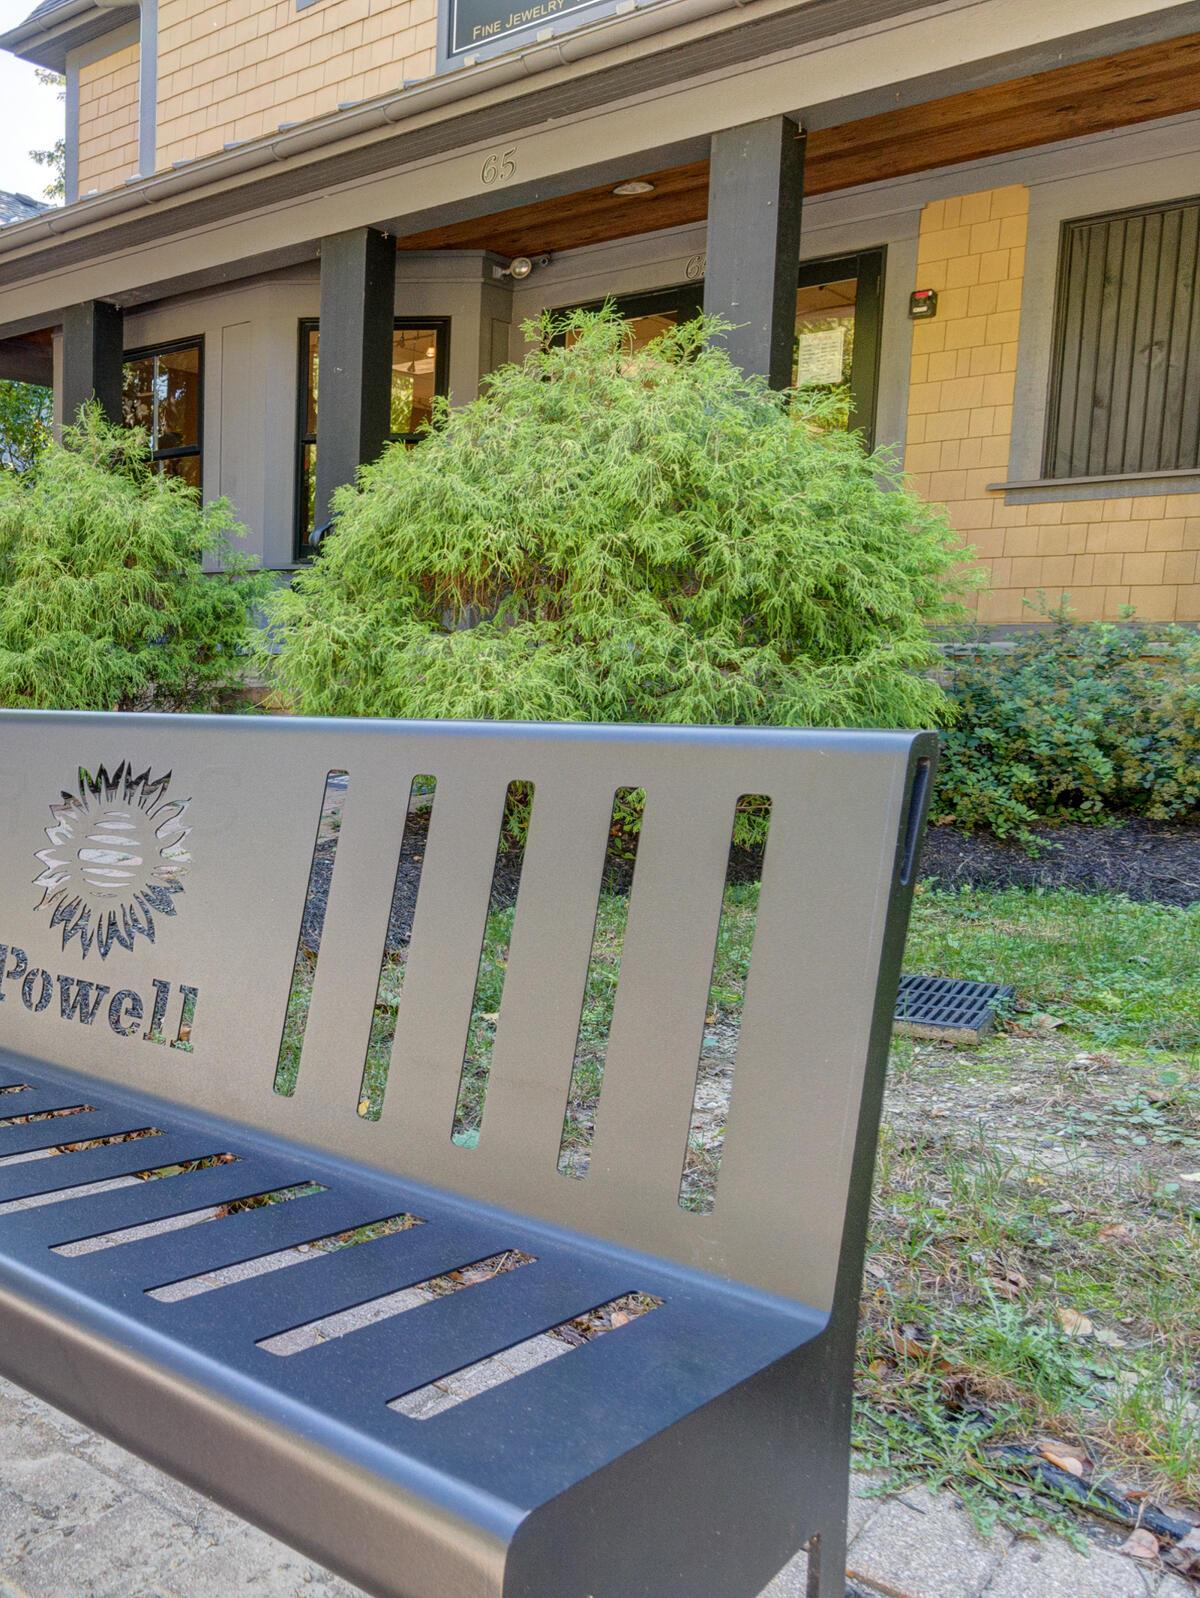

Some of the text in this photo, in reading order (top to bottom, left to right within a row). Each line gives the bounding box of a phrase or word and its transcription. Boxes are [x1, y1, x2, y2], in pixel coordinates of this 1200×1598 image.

[472, 0, 564, 40] FINE JEWELRY
[480, 147, 519, 185] 65
